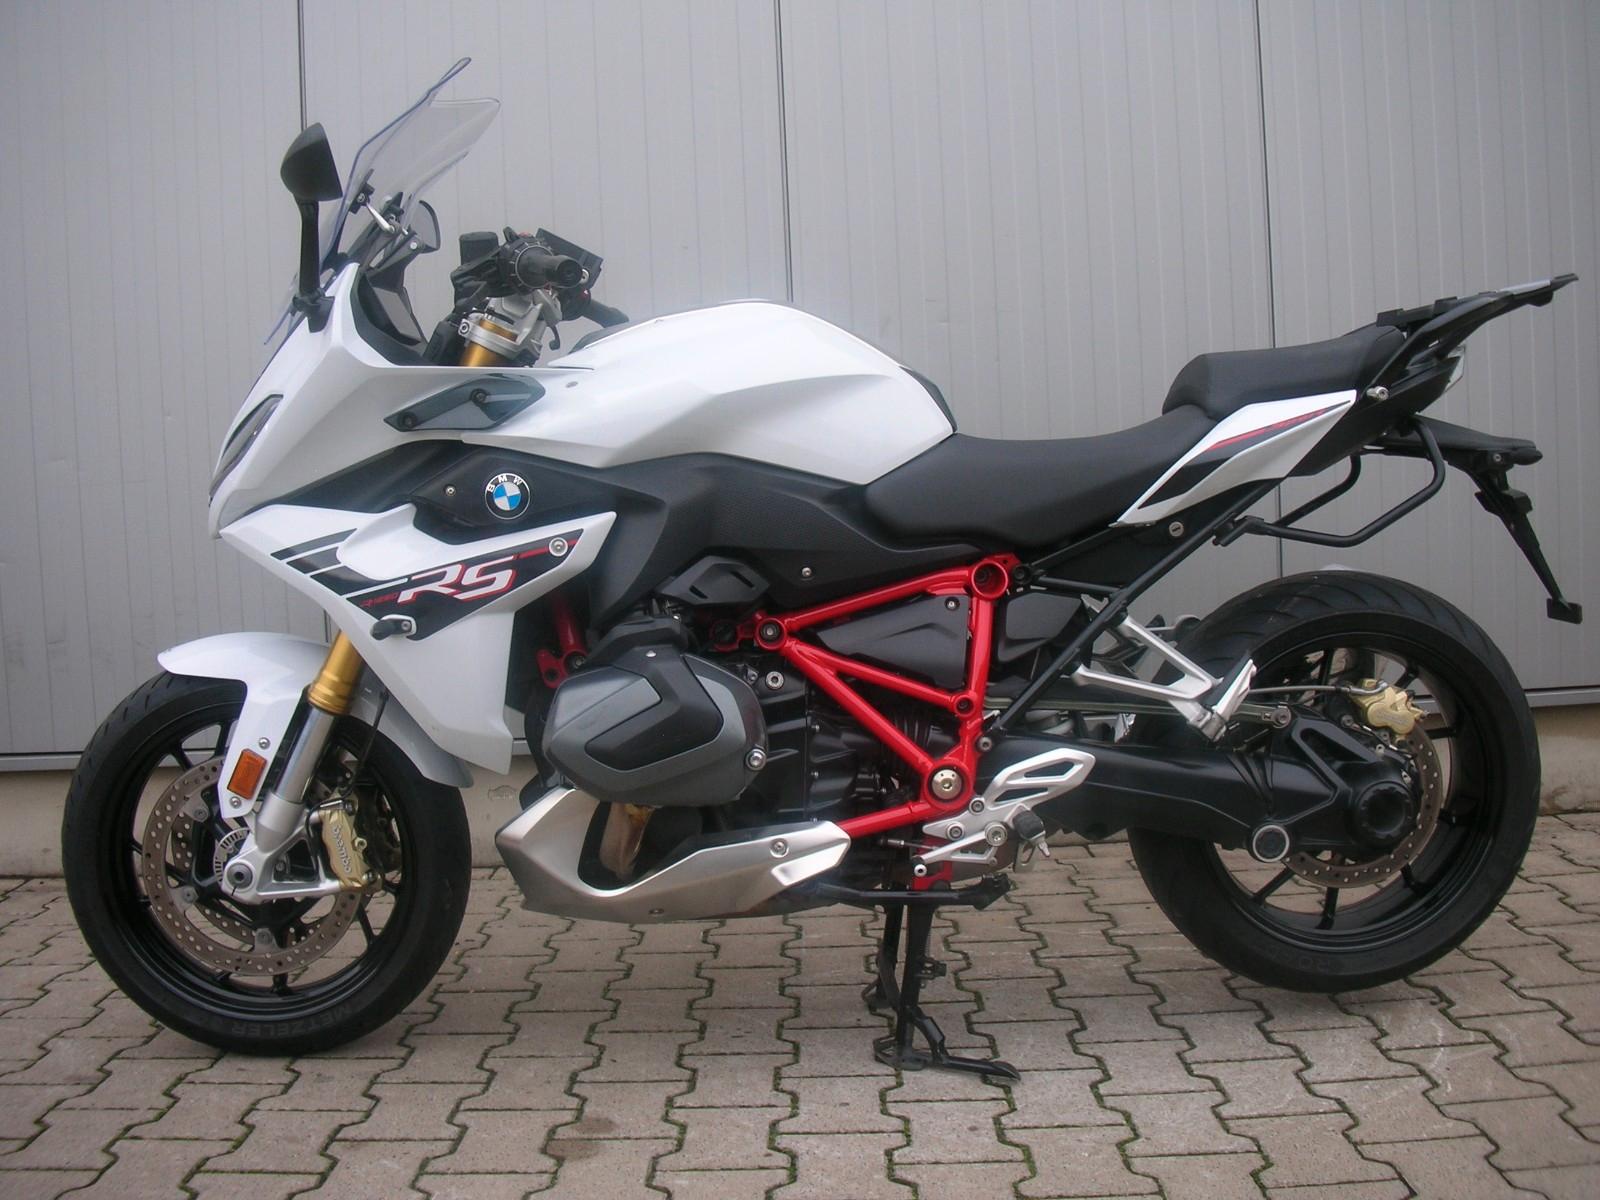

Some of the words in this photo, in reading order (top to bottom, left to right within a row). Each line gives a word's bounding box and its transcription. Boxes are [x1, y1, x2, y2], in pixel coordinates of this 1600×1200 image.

[487, 475, 523, 492] BMW
[397, 555, 516, 603] RS
[333, 825, 352, 873] brembo
[232, 1003, 353, 1037] METZELER
